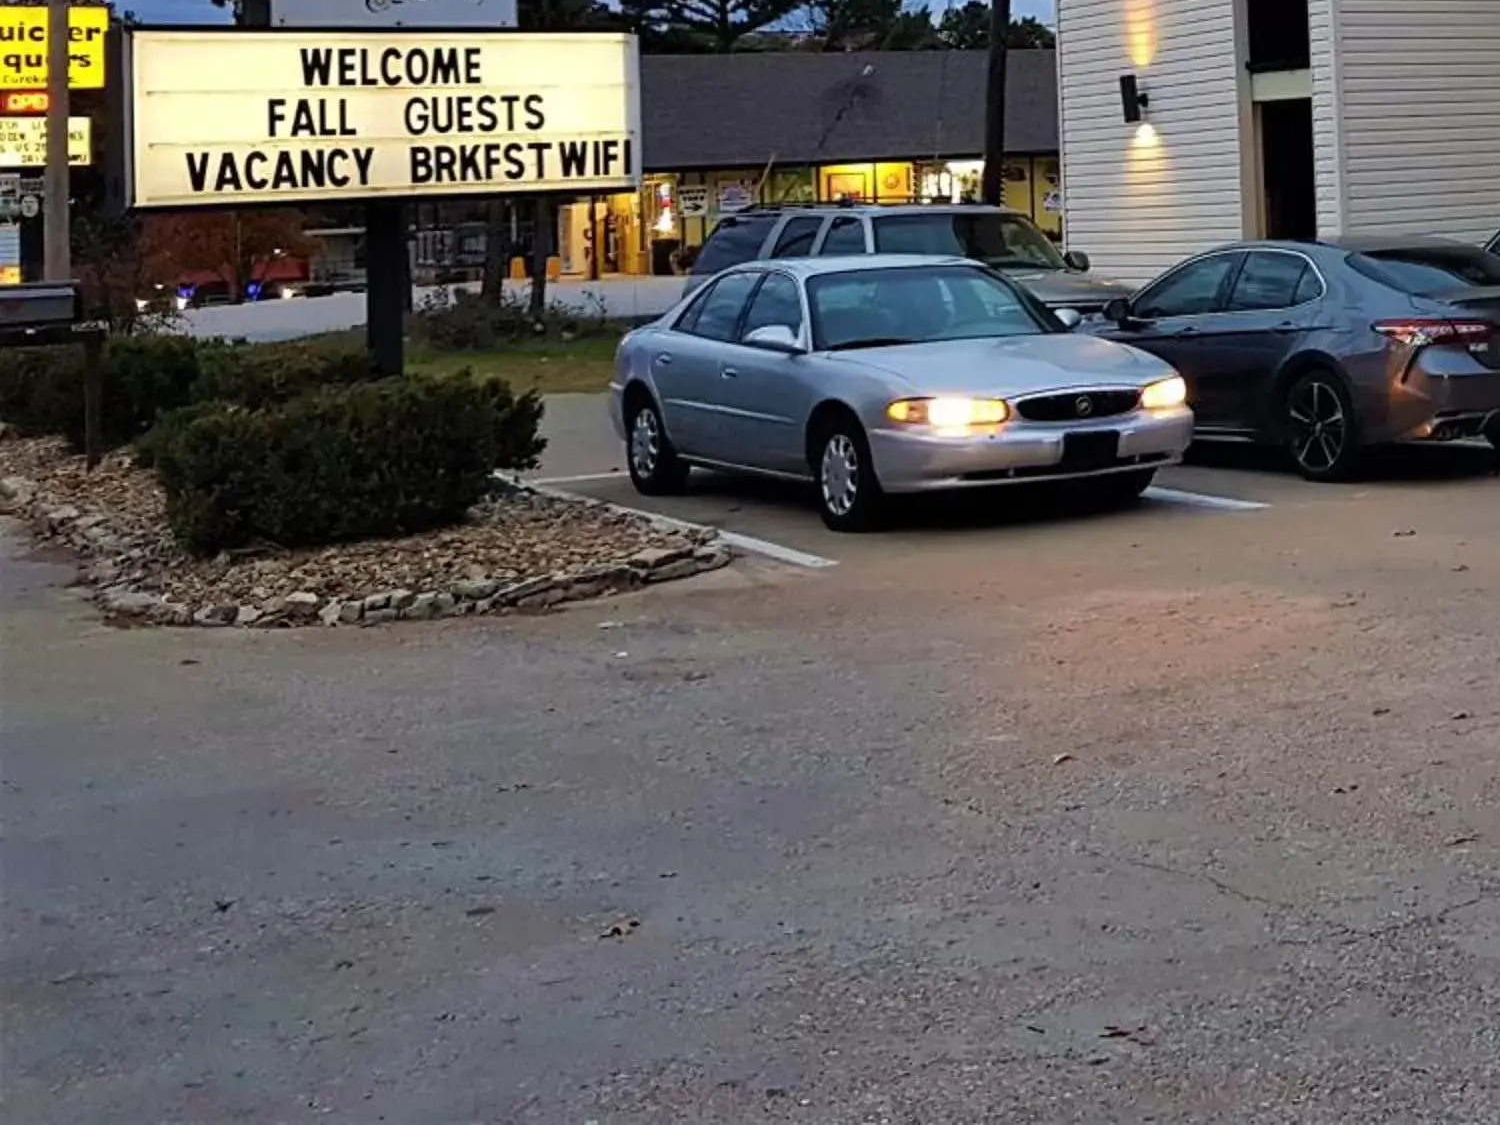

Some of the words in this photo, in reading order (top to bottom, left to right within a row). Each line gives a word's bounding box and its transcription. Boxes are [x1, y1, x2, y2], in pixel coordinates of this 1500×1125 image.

[0, 21, 101, 42] uicer
[301, 47, 481, 86] WELCOME
[268, 98, 357, 137] FALL
[404, 94, 545, 135] GUESTS
[186, 147, 374, 191] VACANCY
[410, 142, 552, 183] BRKFST
[558, 139, 632, 179] WIFI
